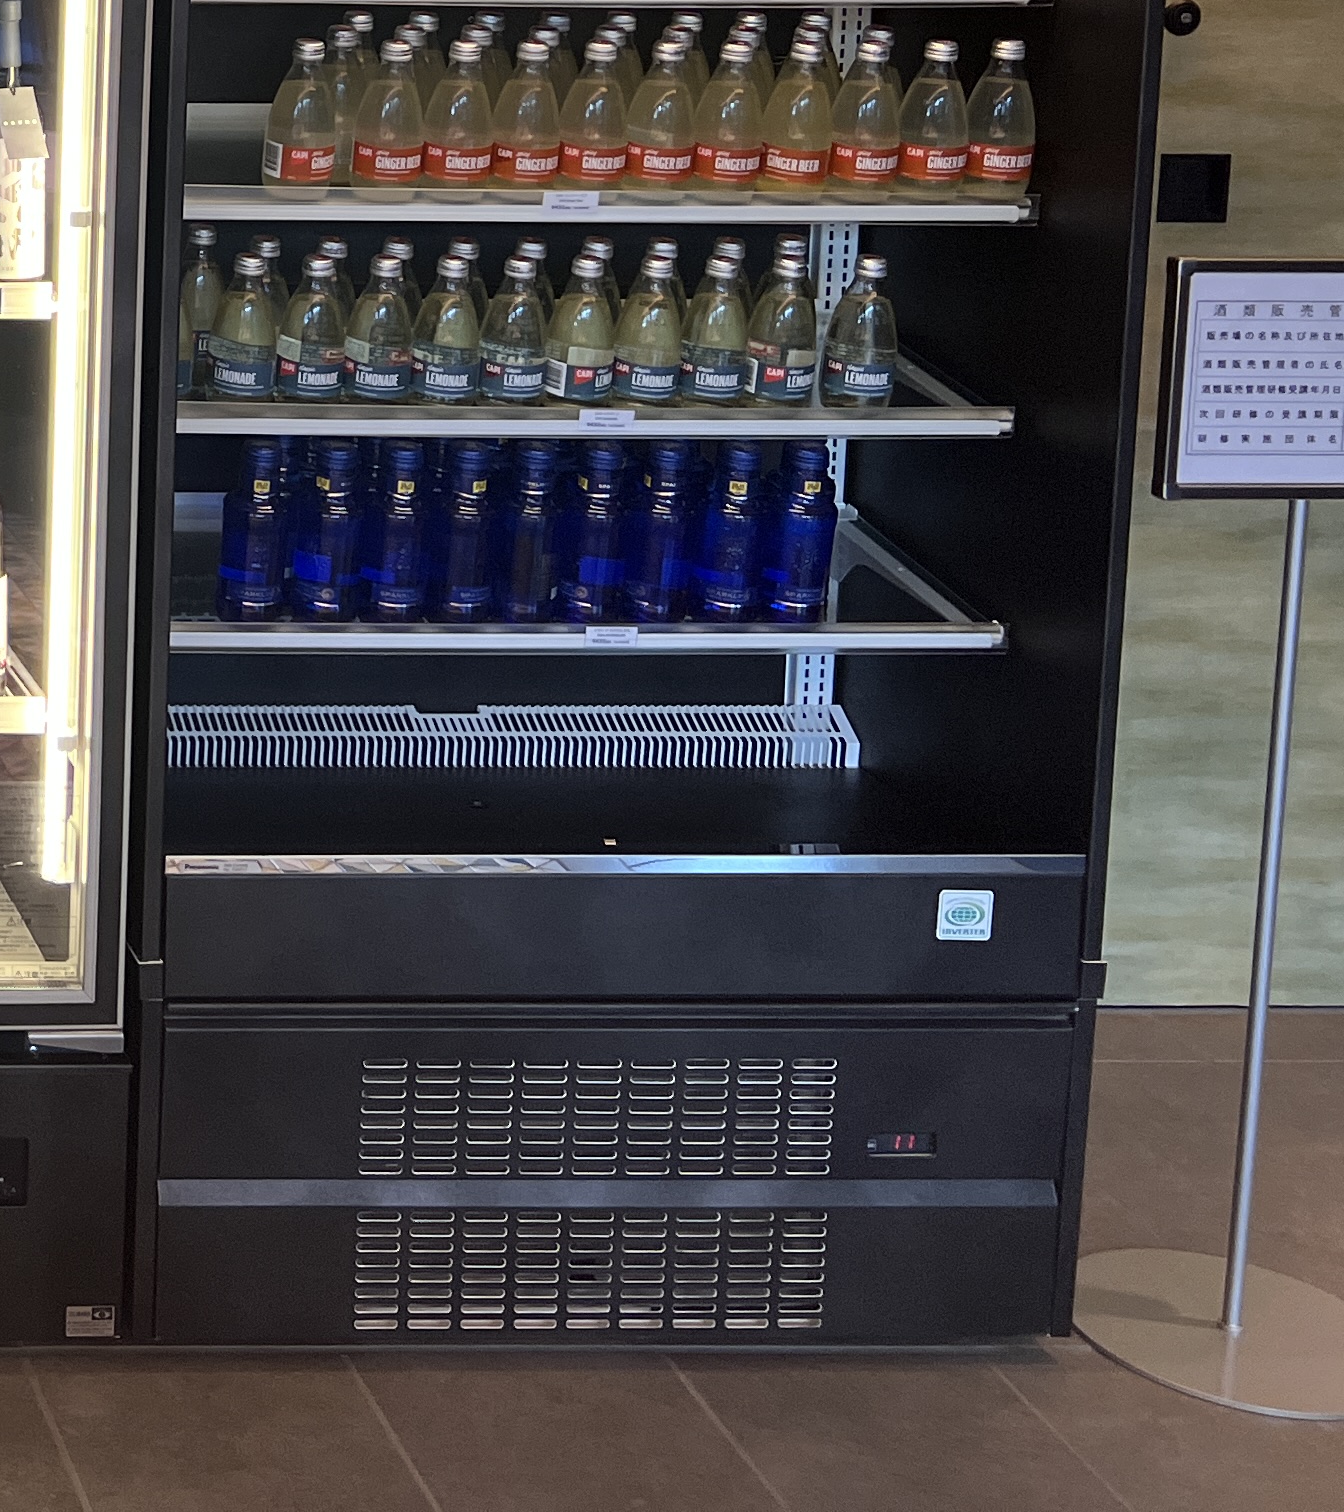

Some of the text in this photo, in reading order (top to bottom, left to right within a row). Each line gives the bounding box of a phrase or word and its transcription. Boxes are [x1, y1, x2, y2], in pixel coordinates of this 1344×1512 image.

[291, 150, 308, 160] CAPI
[643, 155, 675, 170] GINGER
[375, 156, 406, 170] GINGER
[445, 156, 475, 170] GINGER
[515, 157, 546, 172] GINGER
[582, 156, 613, 170] GINGER
[715, 156, 747, 171] GINGER
[766, 154, 819, 173] GINGER BEER
[214, 367, 257, 386] LEMONADE
[298, 371, 339, 386] LEMONADE
[355, 370, 399, 387] LEMONADE
[425, 370, 469, 386] LEMONADE
[503, 371, 544, 387] LEMONADE
[632, 372, 674, 388] LEMONADE
